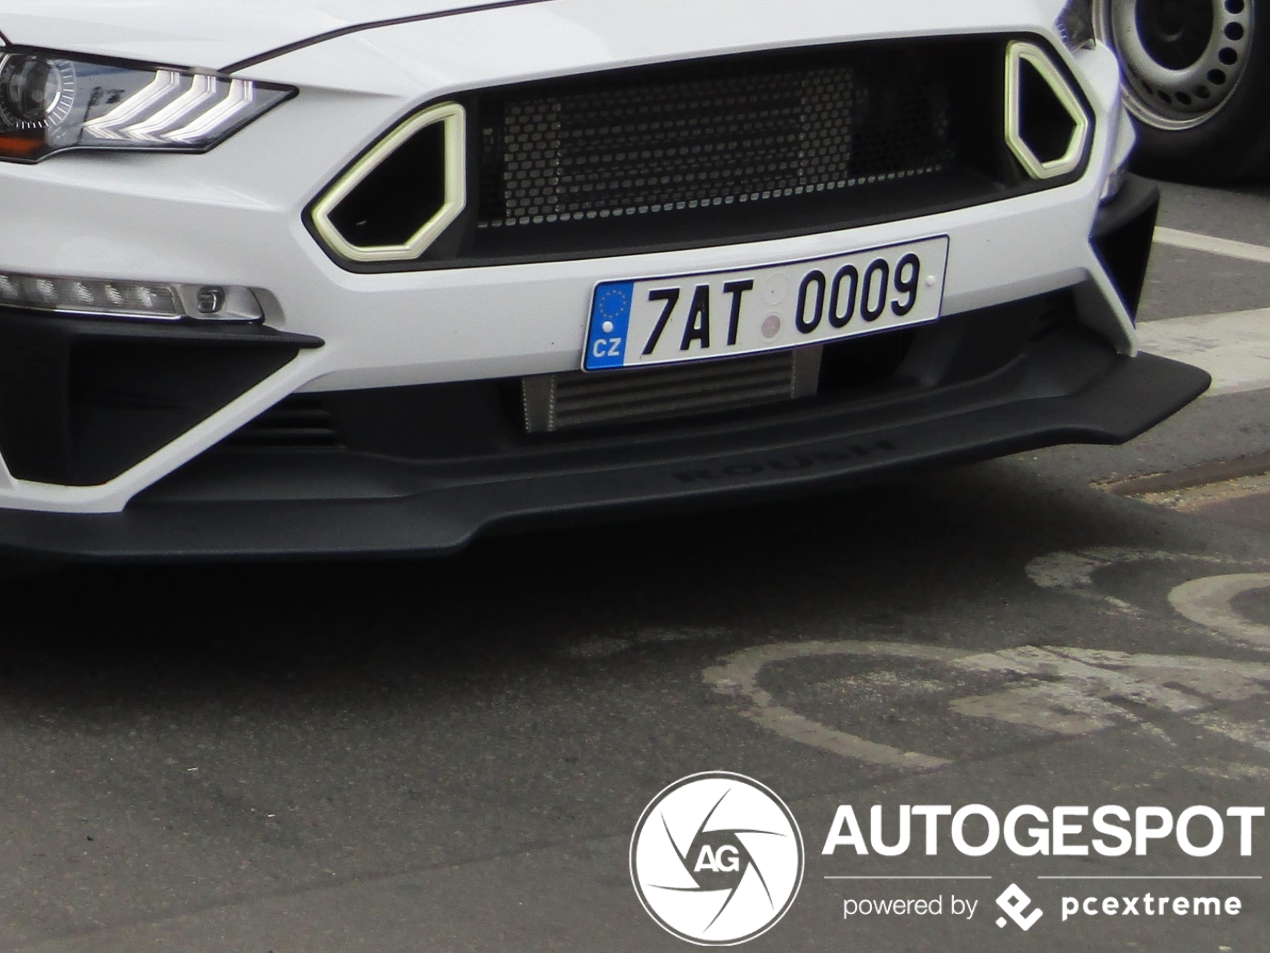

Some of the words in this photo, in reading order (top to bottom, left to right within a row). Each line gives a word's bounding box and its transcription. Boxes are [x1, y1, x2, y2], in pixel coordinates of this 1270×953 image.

[593, 338, 620, 358] CZ
[641, 278, 755, 356] 7AT
[795, 252, 920, 335] 0009
